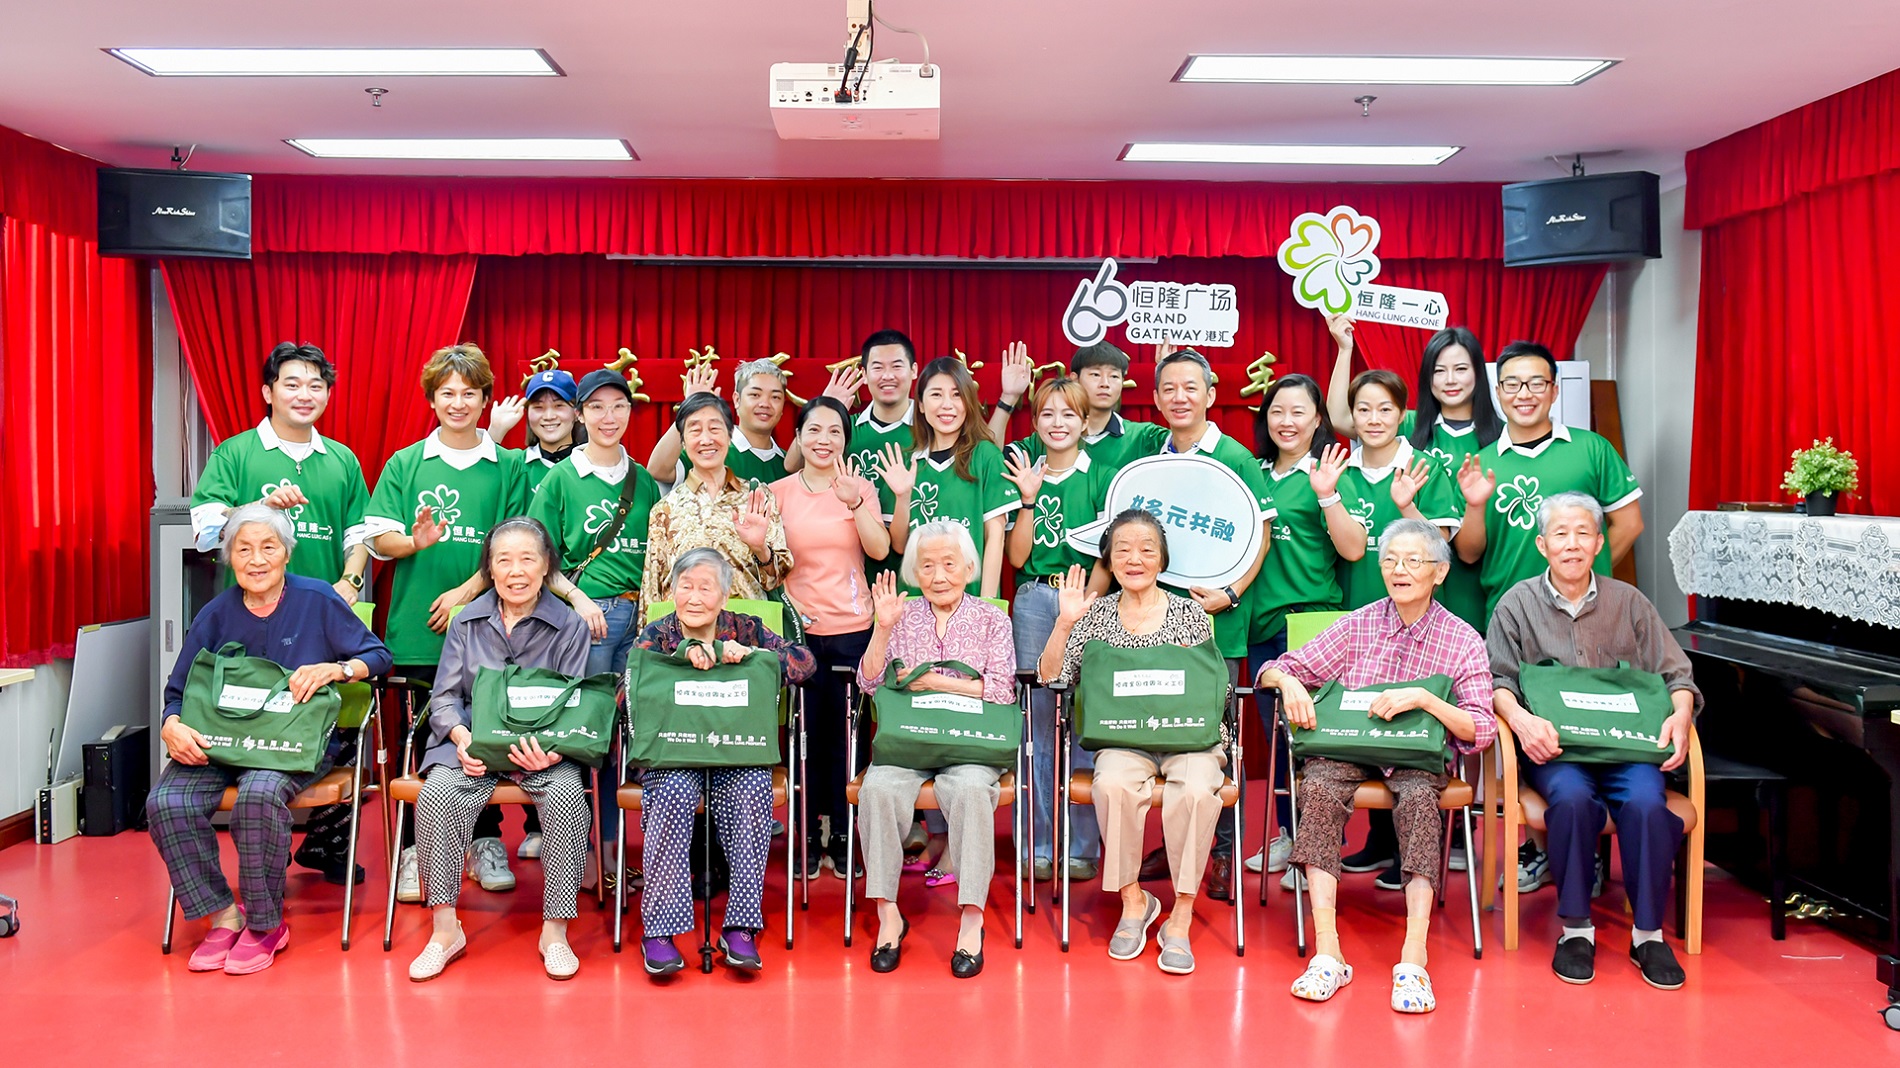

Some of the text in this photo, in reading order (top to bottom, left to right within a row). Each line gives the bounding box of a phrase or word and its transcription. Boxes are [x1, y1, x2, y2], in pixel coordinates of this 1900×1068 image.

[1132, 286, 1231, 311] 恒隆广场
[1357, 290, 1441, 315] 恒隆一心
[1131, 312, 1187, 324] GRAND
[1356, 309, 1440, 327] HANG LUNG AS ONE
[1130, 328, 1229, 343] GATEWAY 港汇
[542, 371, 555, 383] C
[1130, 494, 1236, 543] #多元共融
